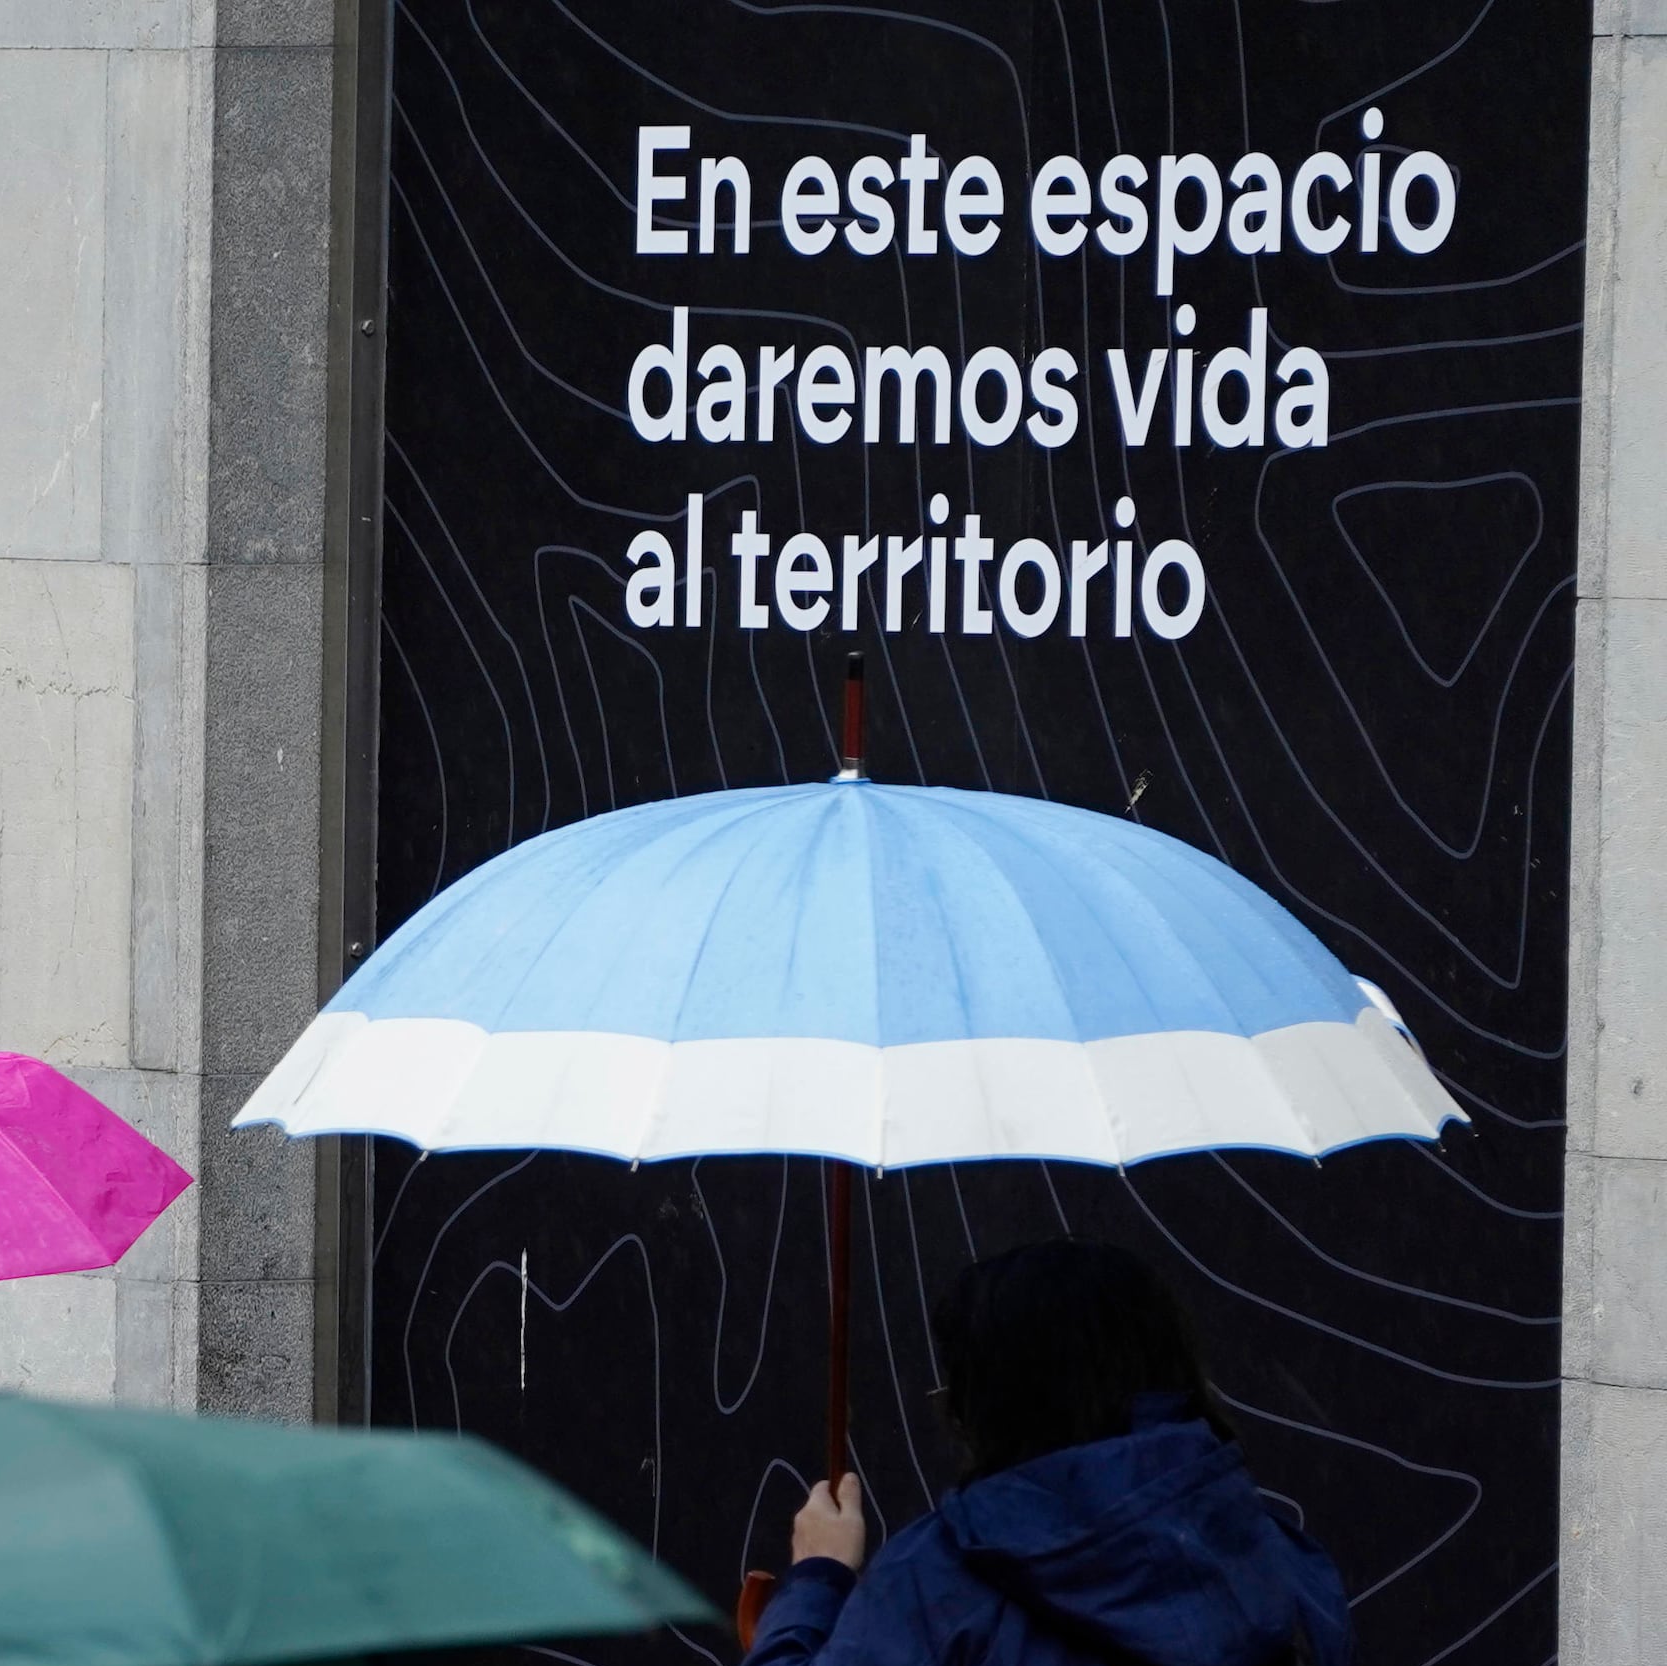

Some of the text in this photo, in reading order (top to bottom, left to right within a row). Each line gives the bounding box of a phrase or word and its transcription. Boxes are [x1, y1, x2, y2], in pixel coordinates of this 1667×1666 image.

[636, 107, 1457, 297] En este espacio
[627, 303, 1331, 449] daremos vida
[625, 493, 1207, 640] al territorio
